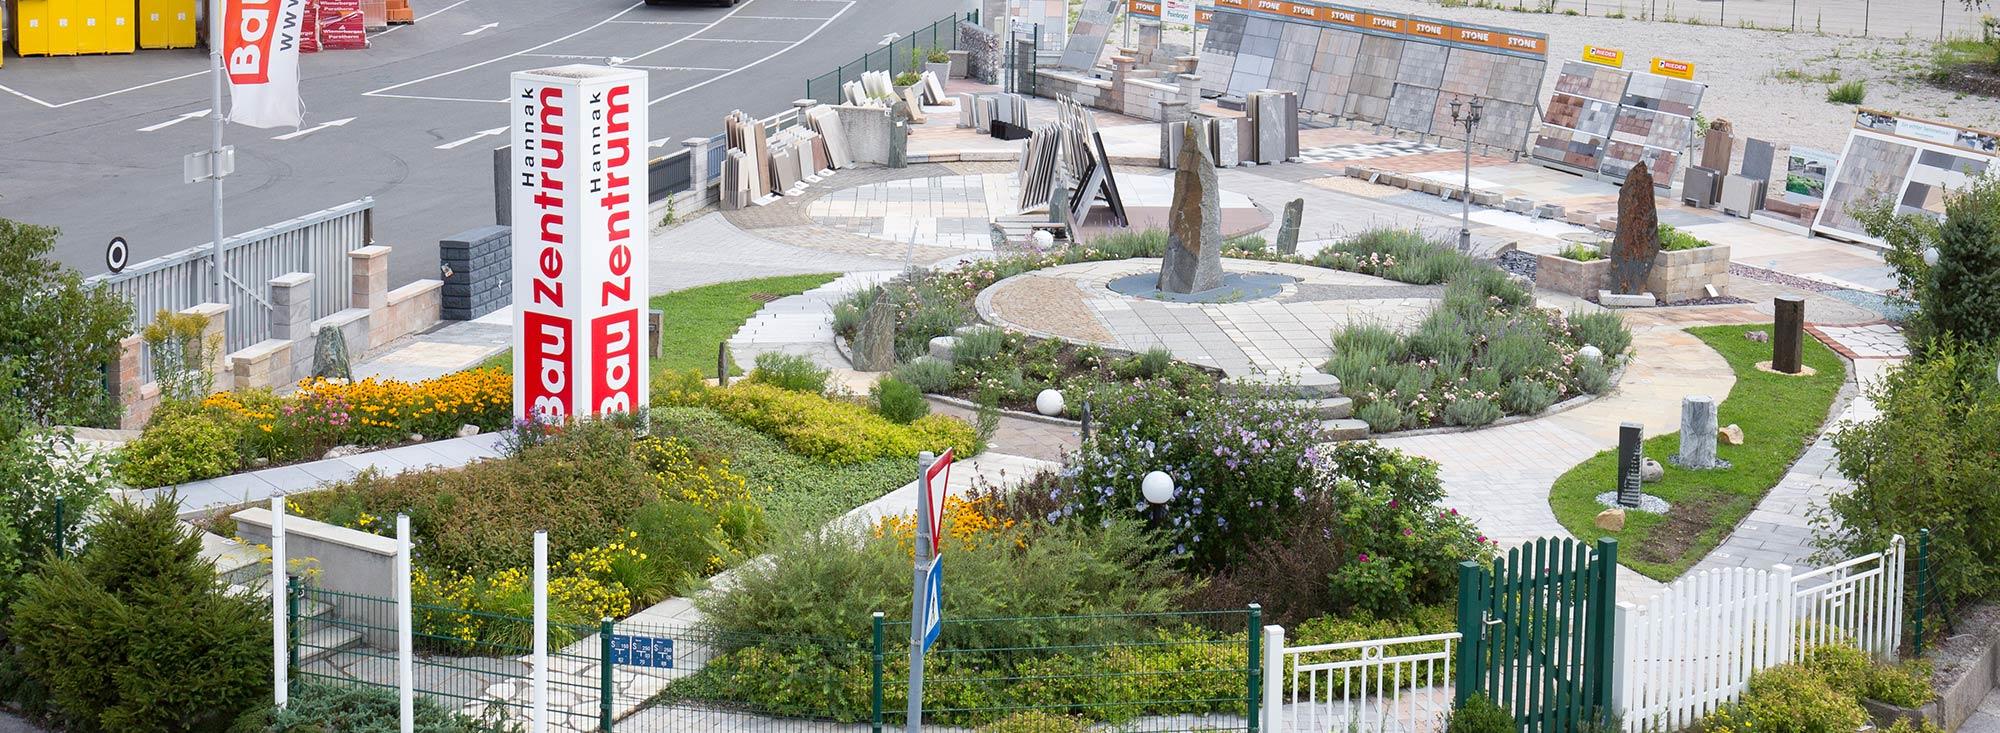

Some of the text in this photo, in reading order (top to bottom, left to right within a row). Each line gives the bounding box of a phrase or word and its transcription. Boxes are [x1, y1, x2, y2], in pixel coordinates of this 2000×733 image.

[1257, 1, 1281, 11] STONE
[1293, 5, 1315, 16] STONE
[1331, 11, 1356, 22] STONE
[1372, 17, 1397, 29] STONE
[1416, 23, 1442, 35] STONE
[230, 0, 270, 75] Ba
[1461, 30, 1489, 42] STONE
[1508, 37, 1537, 49] STONE
[522, 88, 535, 187] Hannak
[590, 92, 601, 193] Hannak
[601, 85, 632, 307] Zentrum
[533, 86, 565, 428] Bau Zentrum
[611, 640, 616, 648] S
[654, 644, 659, 652] S
